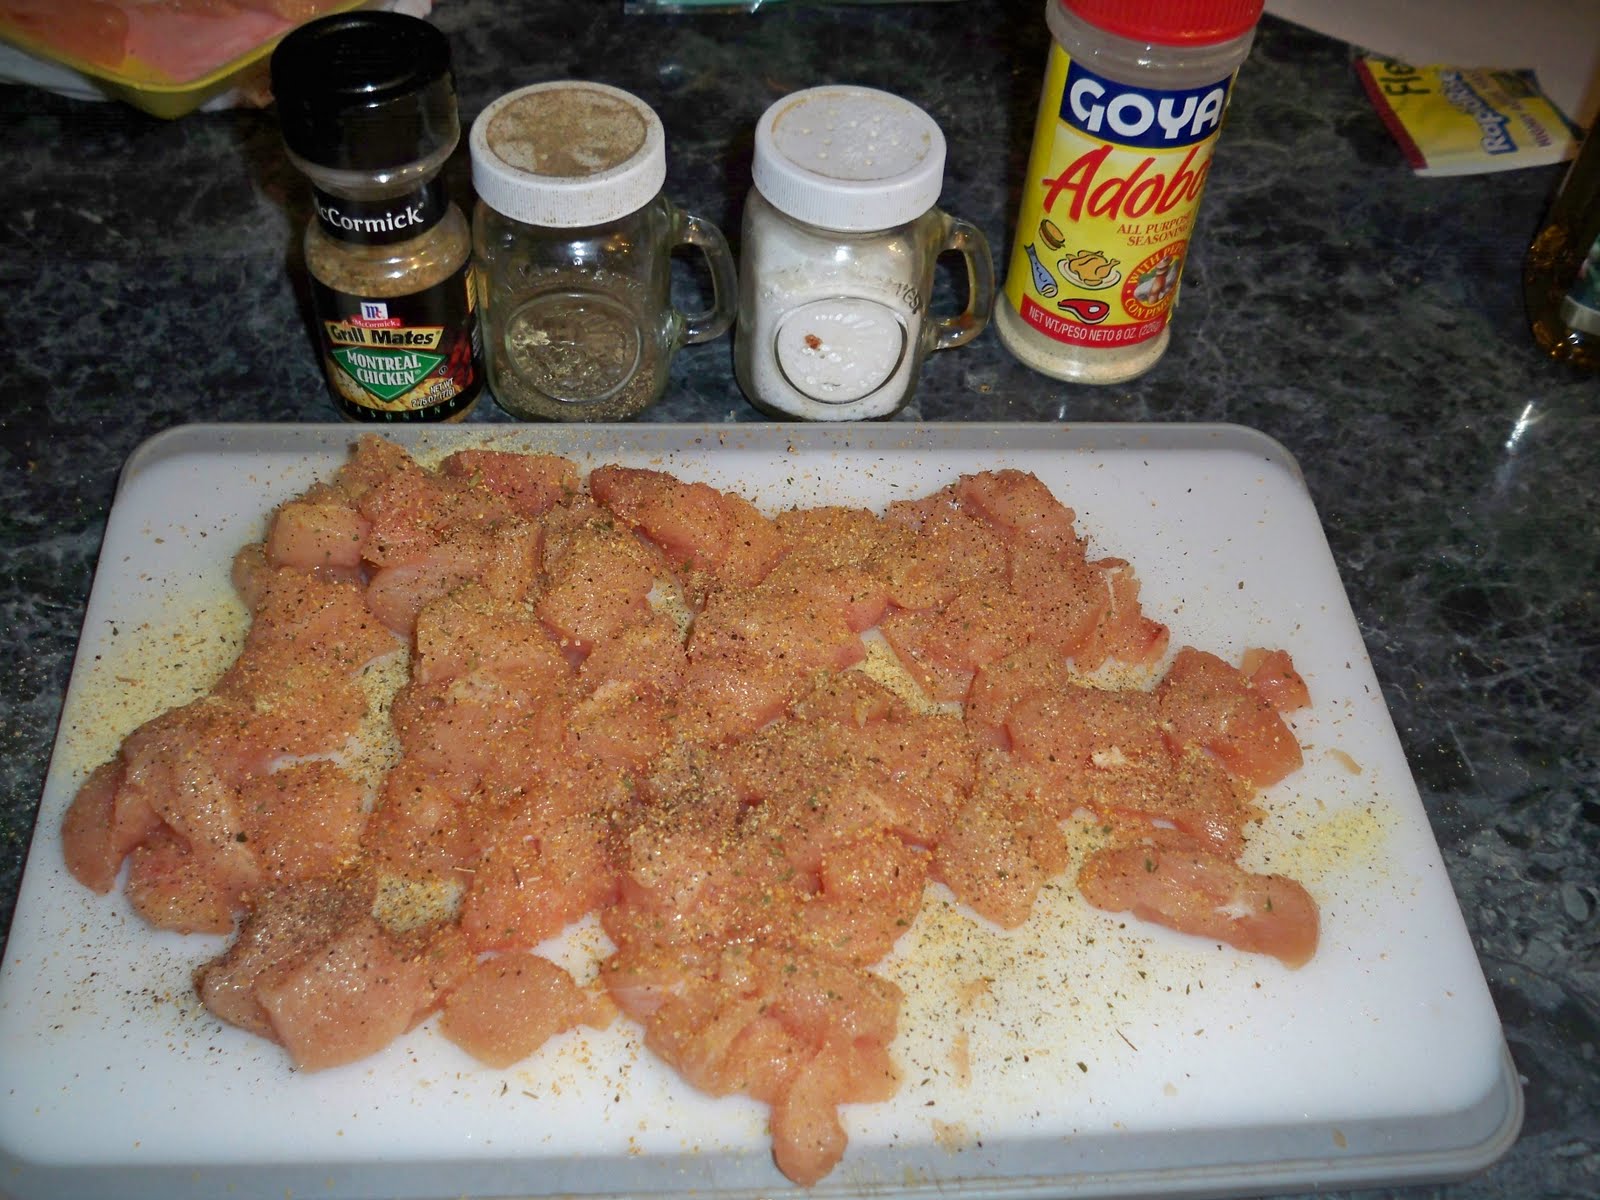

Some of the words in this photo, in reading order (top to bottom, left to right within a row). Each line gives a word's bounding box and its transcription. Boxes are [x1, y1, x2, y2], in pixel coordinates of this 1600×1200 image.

[1069, 78, 1225, 139] GOYA
[1042, 144, 1212, 222] Adobo
[319, 205, 424, 232] cCormick
[1117, 223, 1141, 235] ALL
[1127, 251, 1162, 285] WITH
[1125, 298, 1145, 317] CON
[353, 318, 398, 328] McCormick
[1029, 306, 1043, 324] NET
[1089, 329, 1115, 341] NETO
[1116, 330, 1122, 340] 8
[330, 324, 366, 343] Grill
[371, 329, 434, 345] Mates
[346, 350, 422, 370] MONTREAL
[356, 368, 416, 386] CHICKEN
[430, 383, 443, 395] NET
